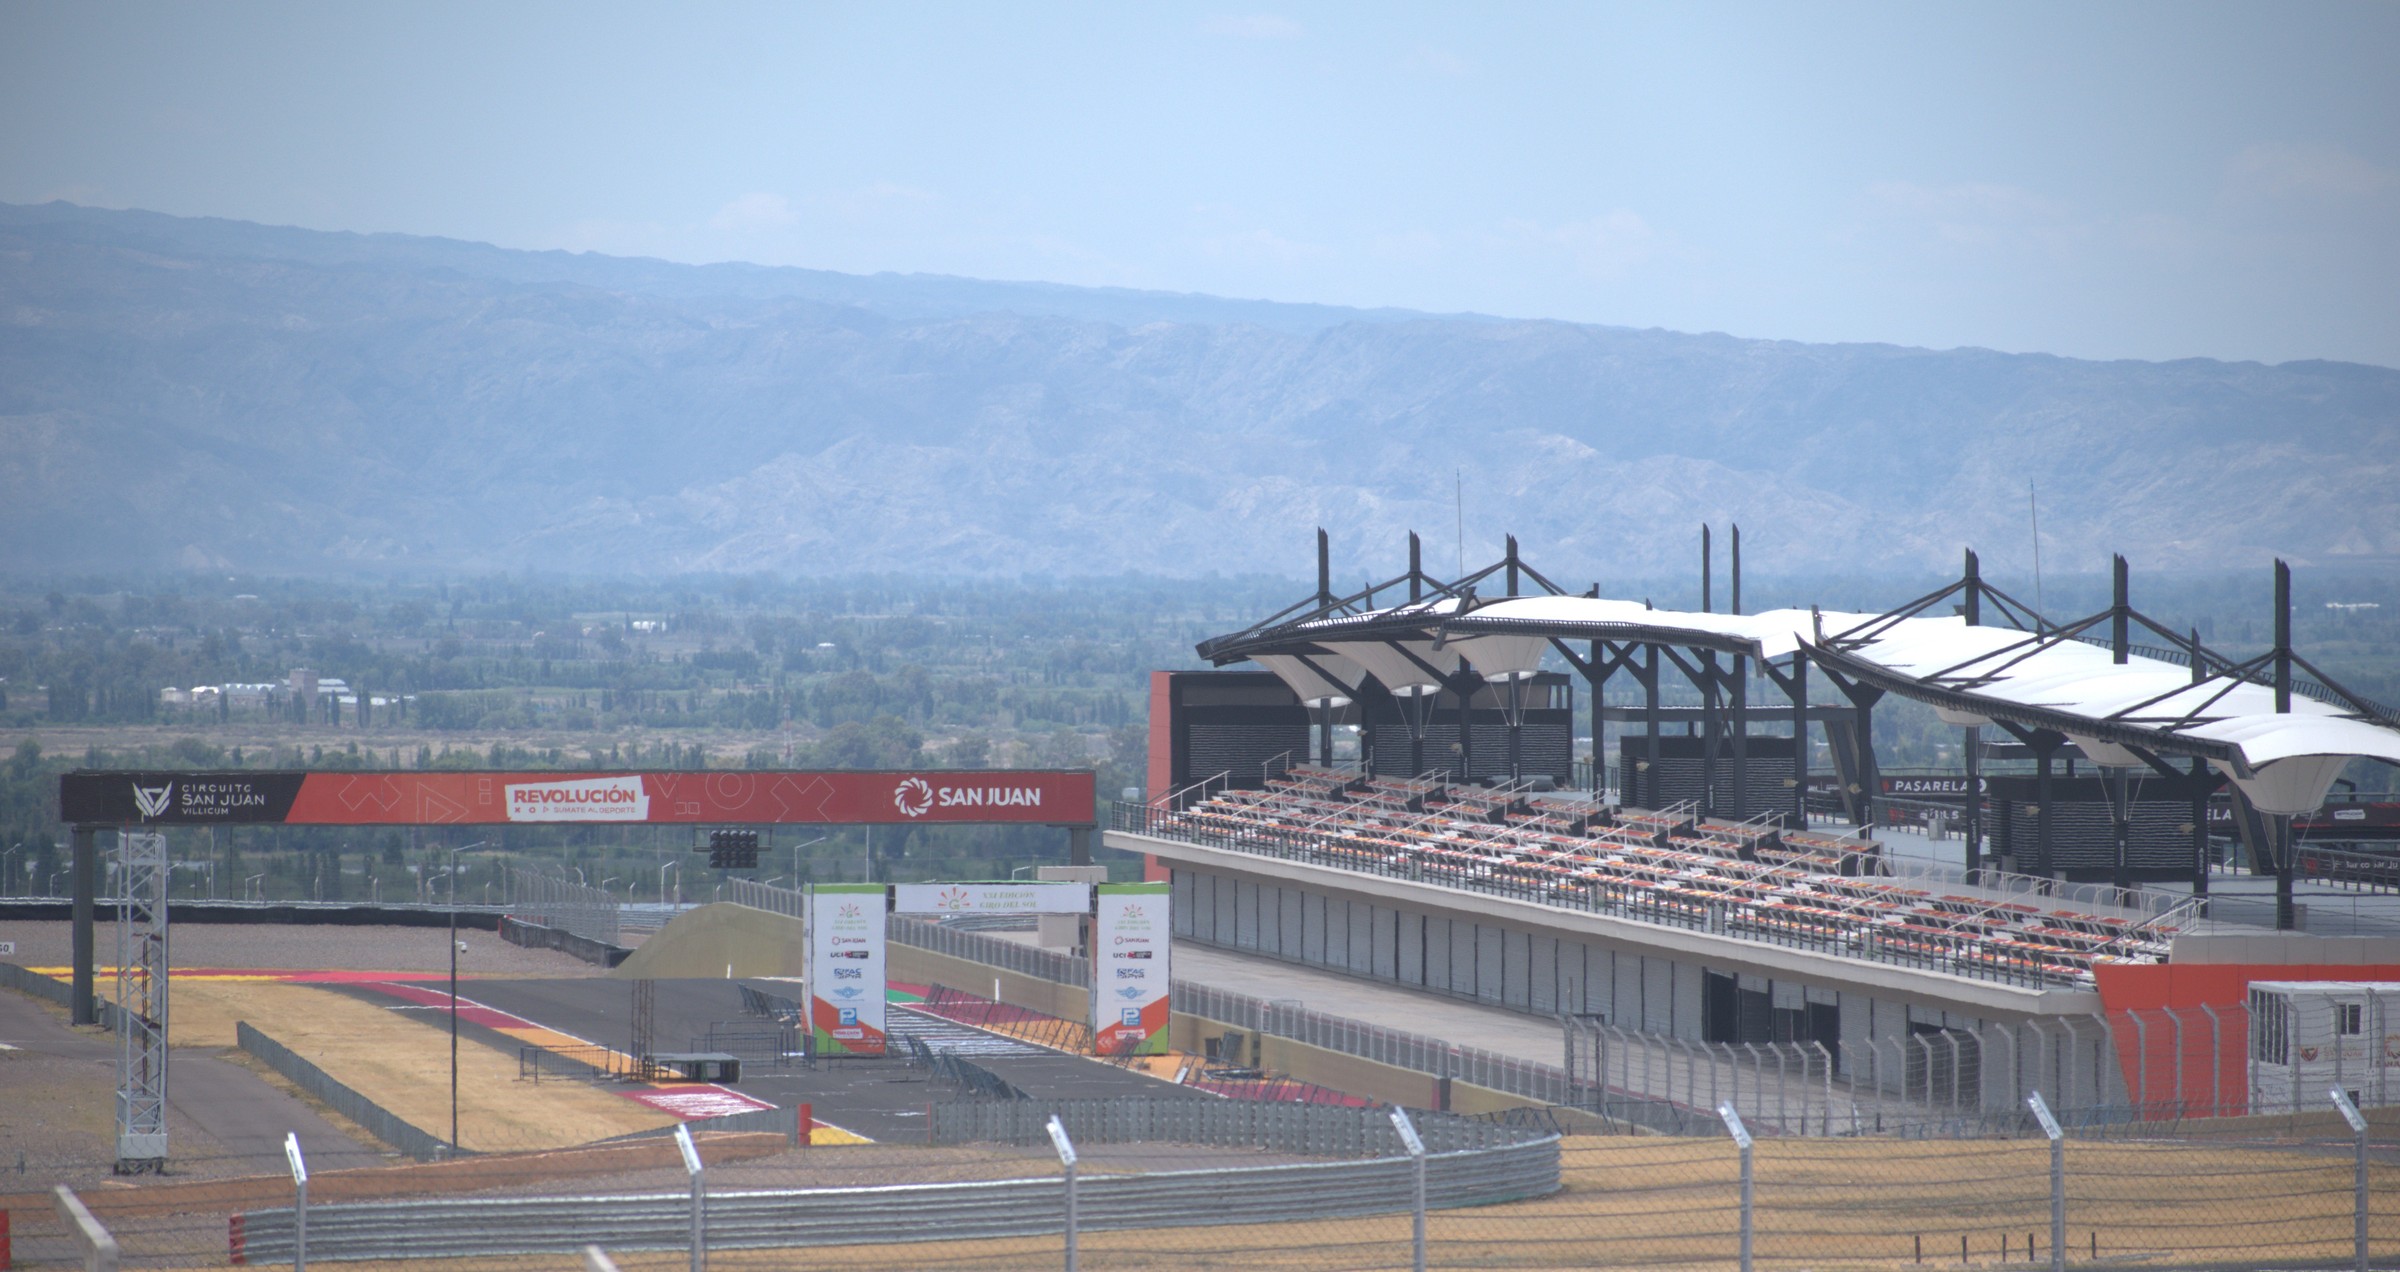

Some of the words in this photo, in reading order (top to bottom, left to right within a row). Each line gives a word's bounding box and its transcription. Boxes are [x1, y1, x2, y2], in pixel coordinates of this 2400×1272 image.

[181, 784, 252, 793] CIRCUITO
[514, 784, 636, 804] REVOLUCIÓN
[938, 787, 983, 806] SAN
[986, 787, 1041, 806] JUAN
[181, 794, 215, 806] SAN
[220, 794, 265, 806] JUAN
[181, 807, 229, 815] VILLICUM
[553, 806, 586, 814] SUMATE
[599, 806, 636, 814] DEPORTE
